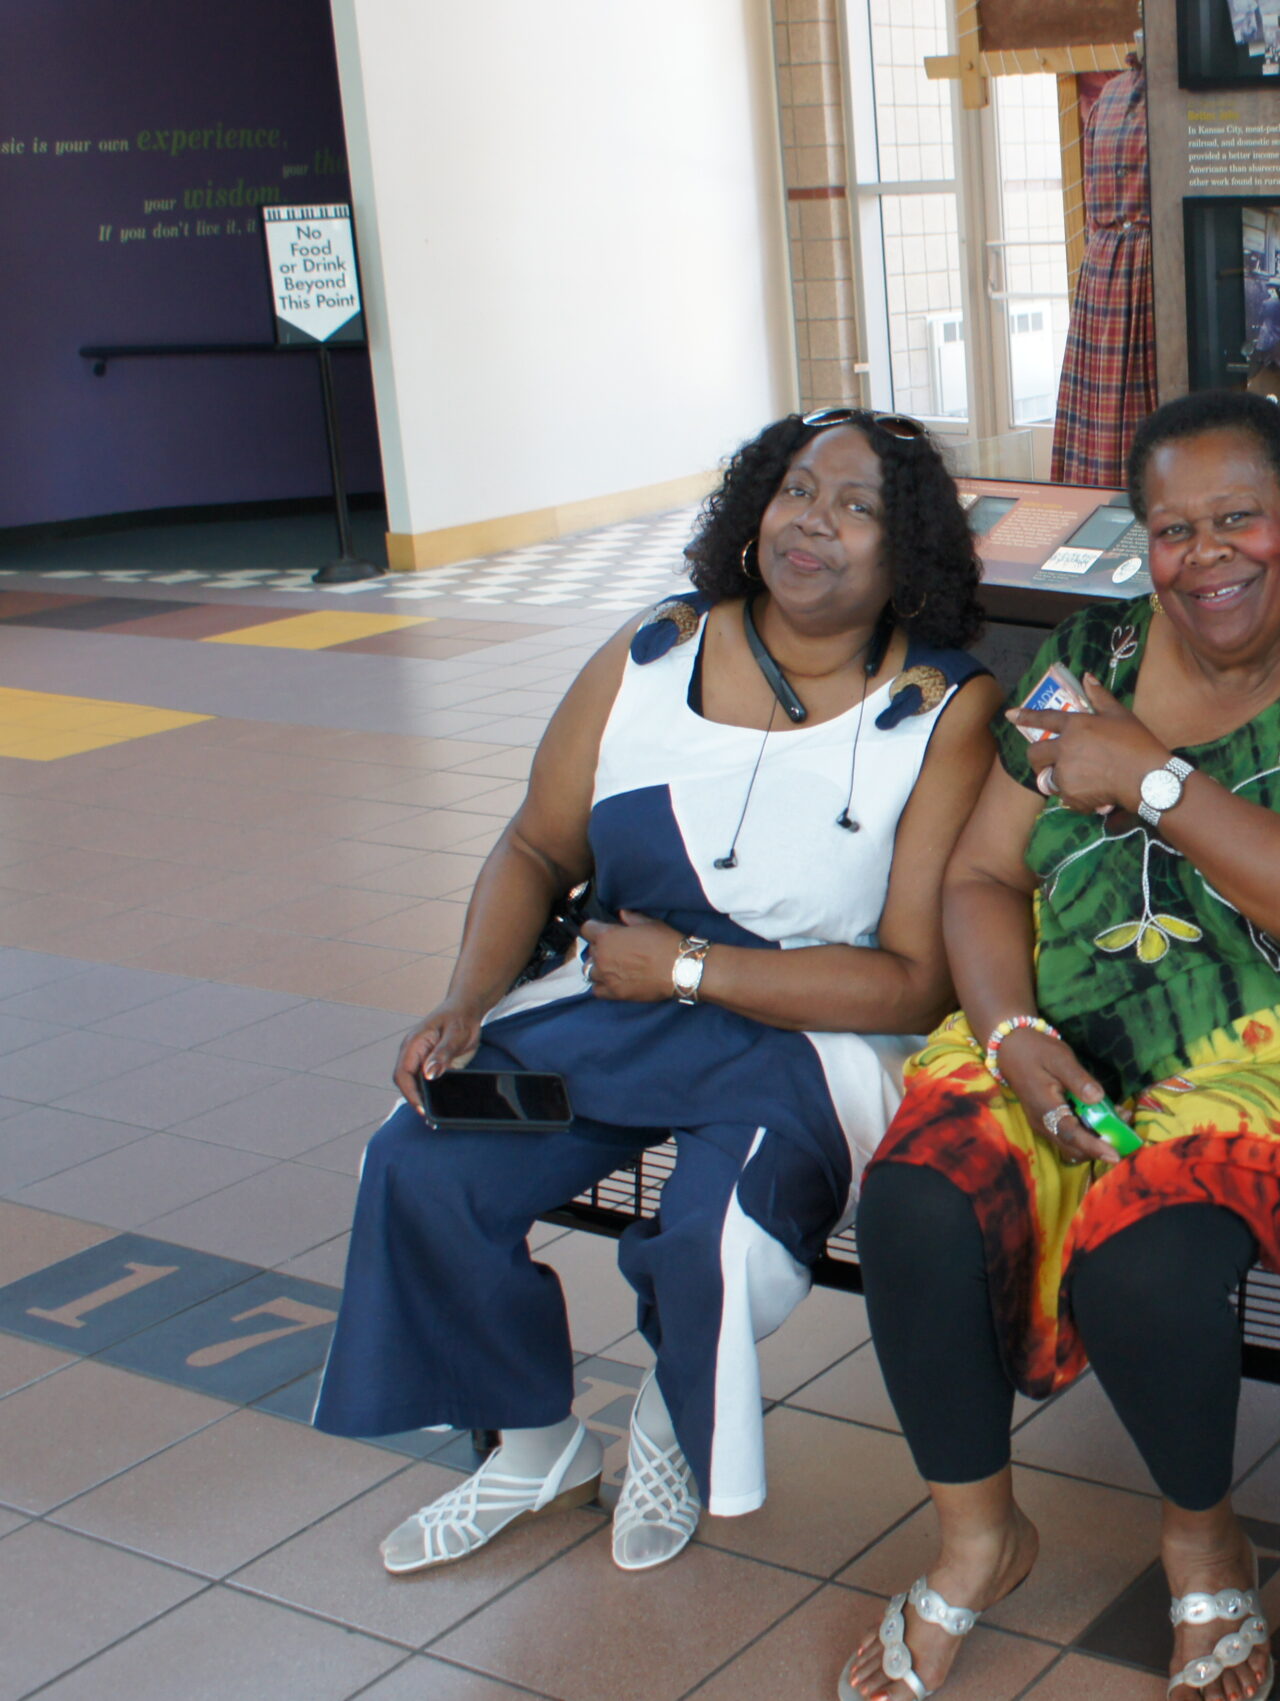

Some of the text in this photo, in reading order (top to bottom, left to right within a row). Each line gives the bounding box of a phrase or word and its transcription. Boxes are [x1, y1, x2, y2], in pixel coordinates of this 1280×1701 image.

[33, 137, 48, 154] is
[55, 139, 92, 155] your
[98, 139, 129, 152] own
[282, 165, 308, 179] your
[144, 199, 177, 215] your
[297, 226, 321, 240] No
[291, 239, 331, 256] Food
[280, 256, 346, 273] or Drink
[284, 272, 346, 293] Beyond
[279, 293, 354, 310] This Point
